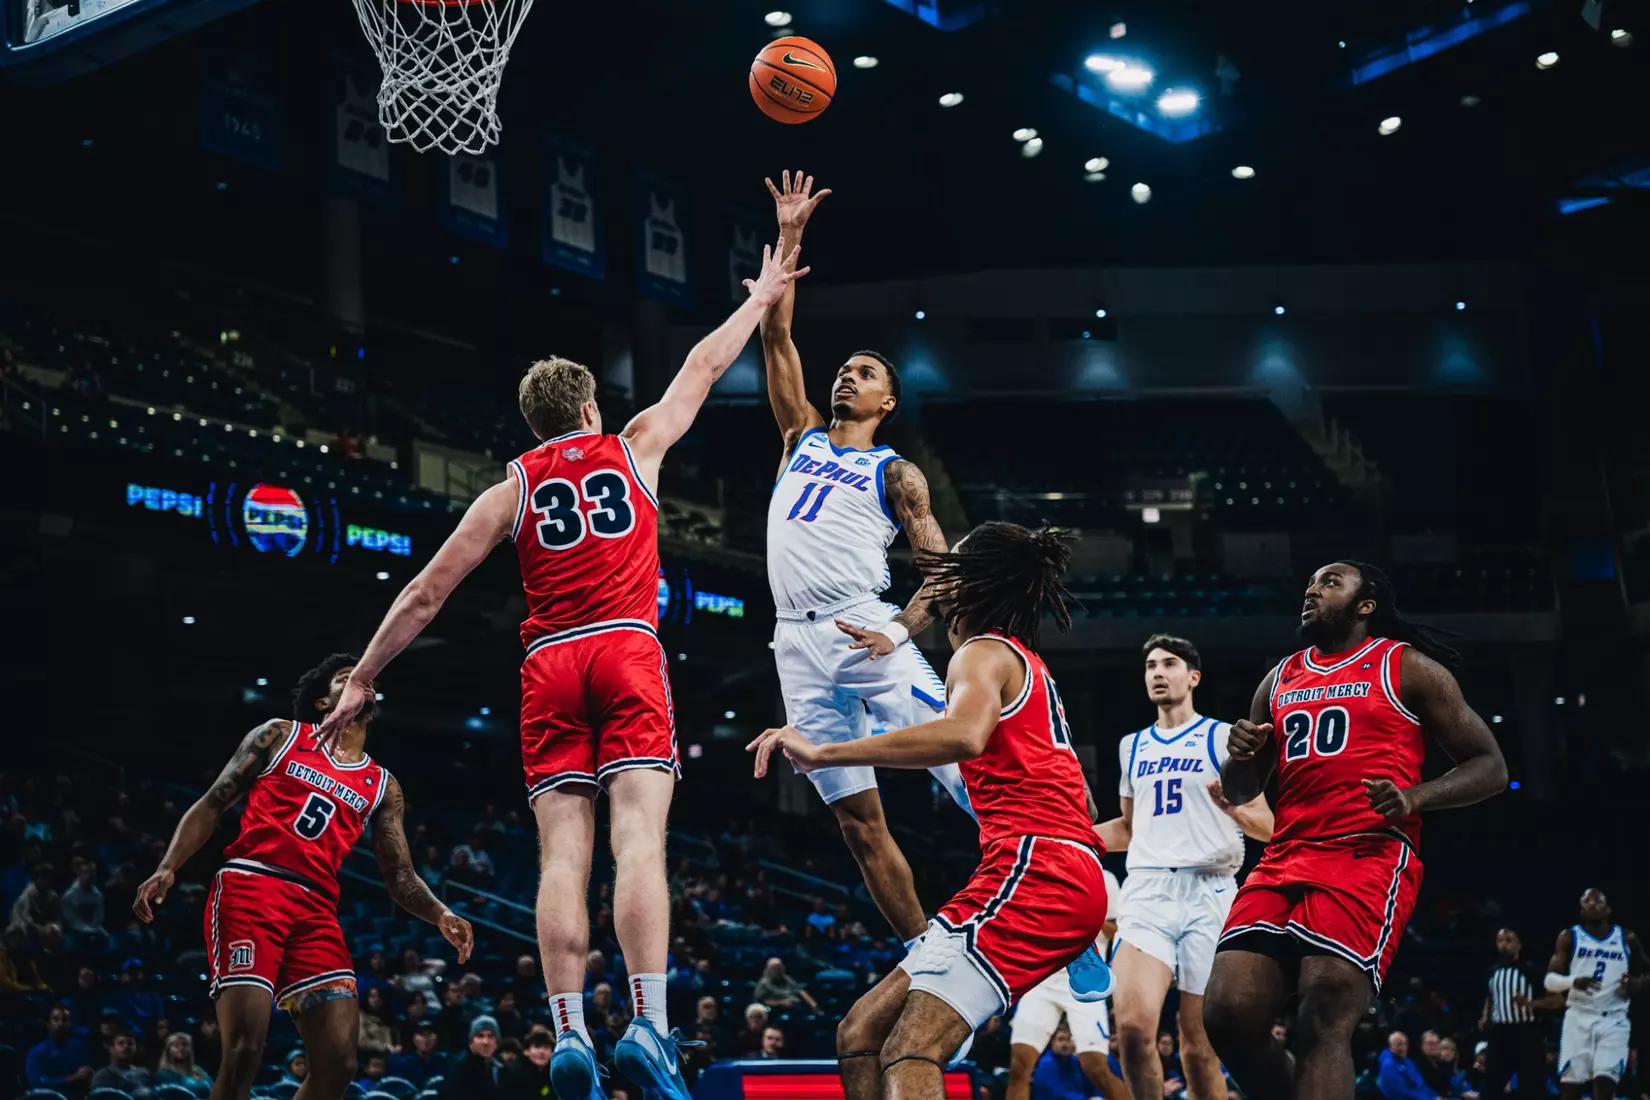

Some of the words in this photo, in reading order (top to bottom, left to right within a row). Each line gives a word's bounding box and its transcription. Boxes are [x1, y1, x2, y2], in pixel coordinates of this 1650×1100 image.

[770, 75, 815, 106] ELITE
[126, 483, 204, 518] PEPSI
[530, 468, 636, 551] 33
[786, 482, 835, 522] 11
[346, 523, 411, 556] PEPSI
[1277, 686, 1325, 709] DETROIT
[1326, 682, 1371, 698] MERCY
[1283, 706, 1349, 762] 20
[285, 760, 335, 792] DETROIT
[333, 782, 369, 813] MERCY
[1153, 778, 1183, 816] 15
[293, 791, 336, 840] 5
[1592, 961, 1607, 982] 2
